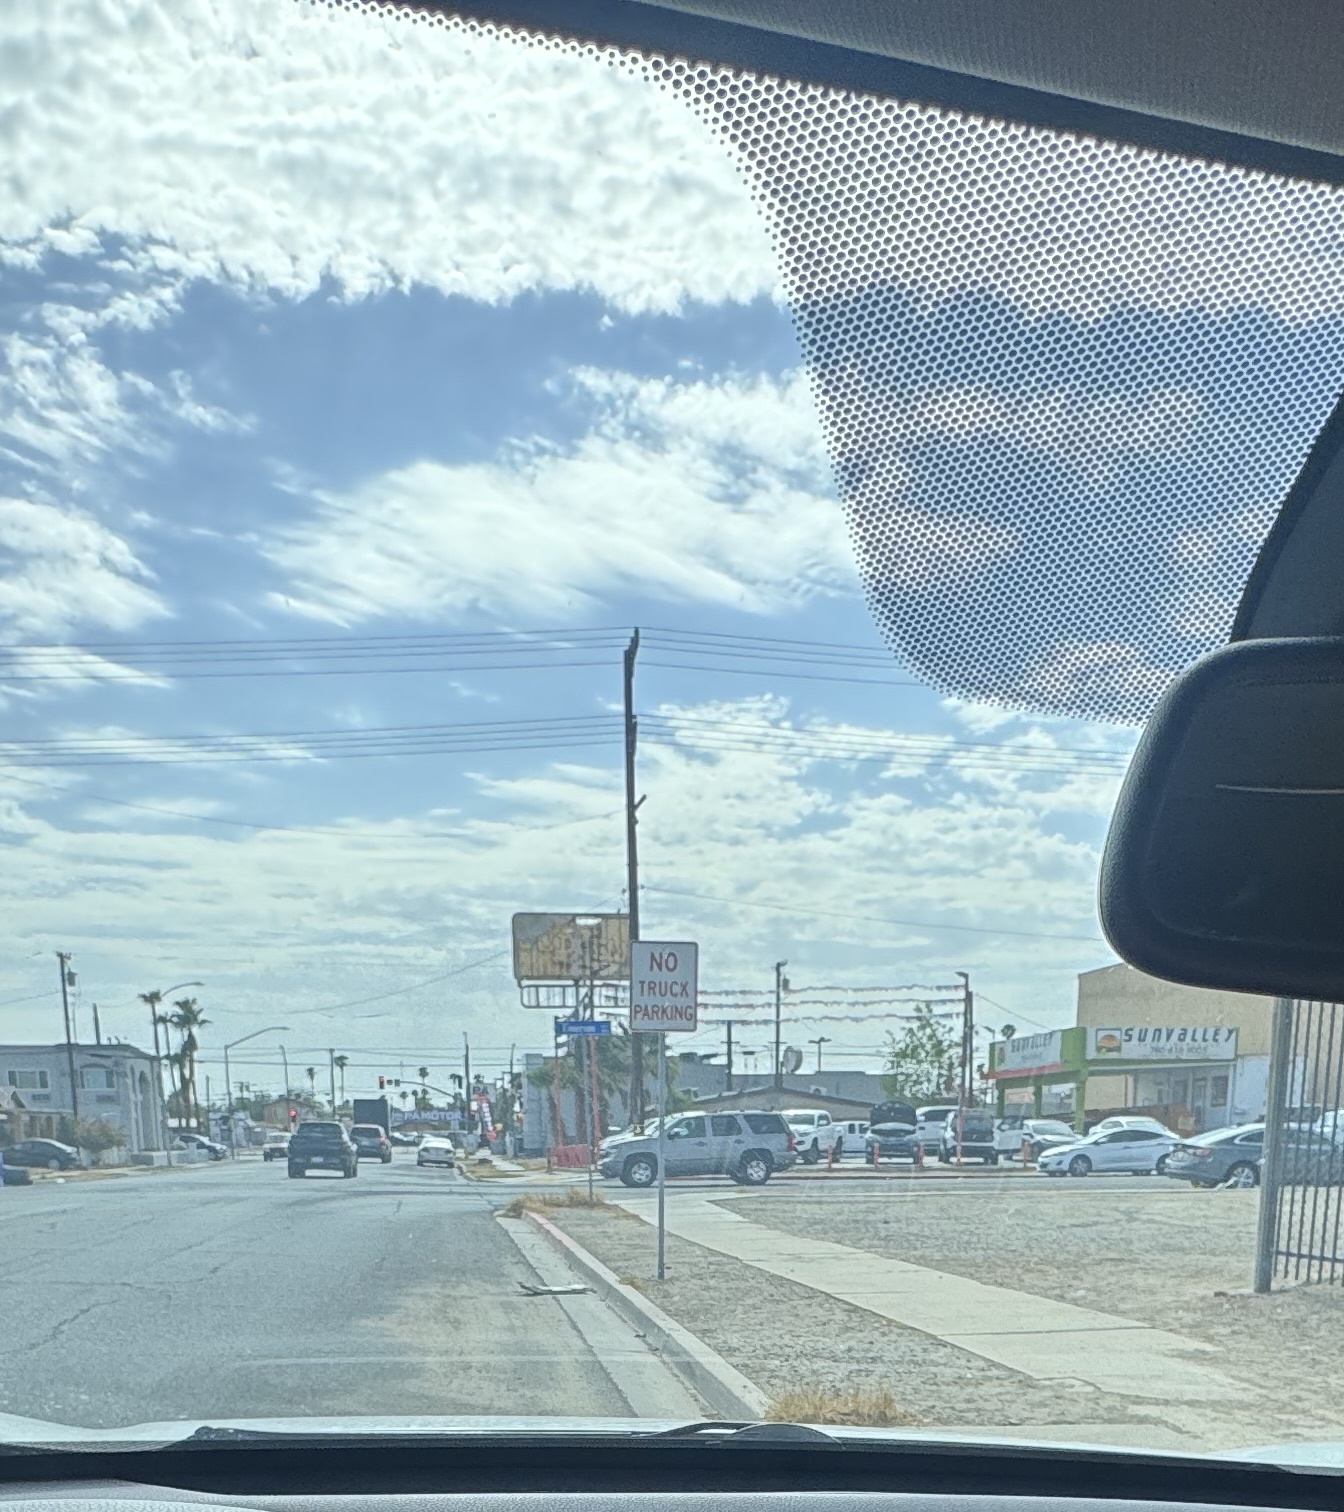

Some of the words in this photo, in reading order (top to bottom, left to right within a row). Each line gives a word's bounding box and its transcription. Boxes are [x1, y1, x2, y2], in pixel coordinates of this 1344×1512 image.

[649, 952, 678, 972] NO
[639, 980, 689, 998] TRUCK
[633, 1004, 694, 1022] PARKING
